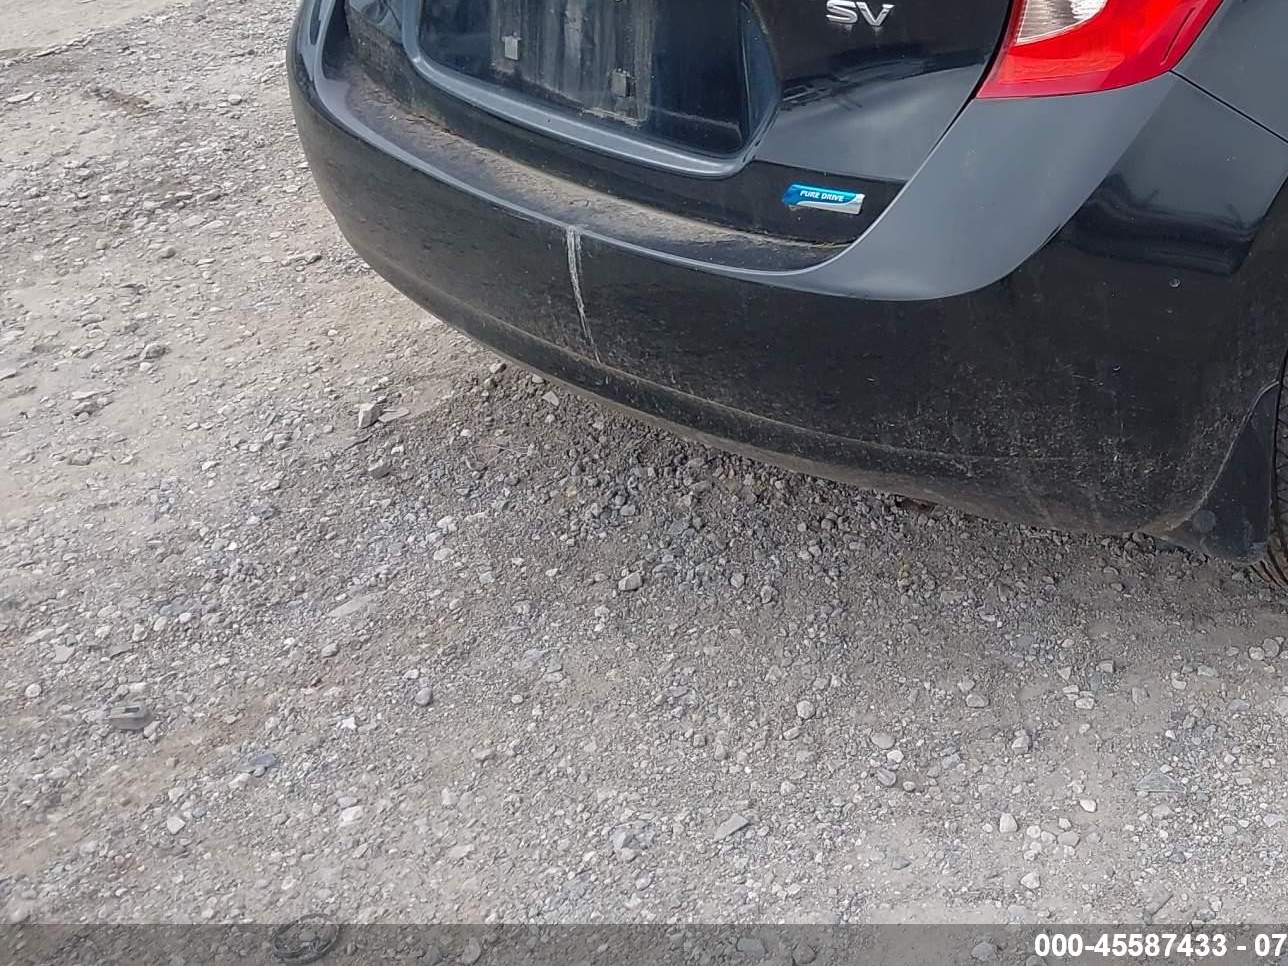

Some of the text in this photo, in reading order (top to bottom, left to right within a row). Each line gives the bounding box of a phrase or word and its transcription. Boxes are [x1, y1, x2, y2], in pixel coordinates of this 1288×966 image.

[825, 0, 896, 26] SV
[800, 190, 845, 202] PURE DRIVE
